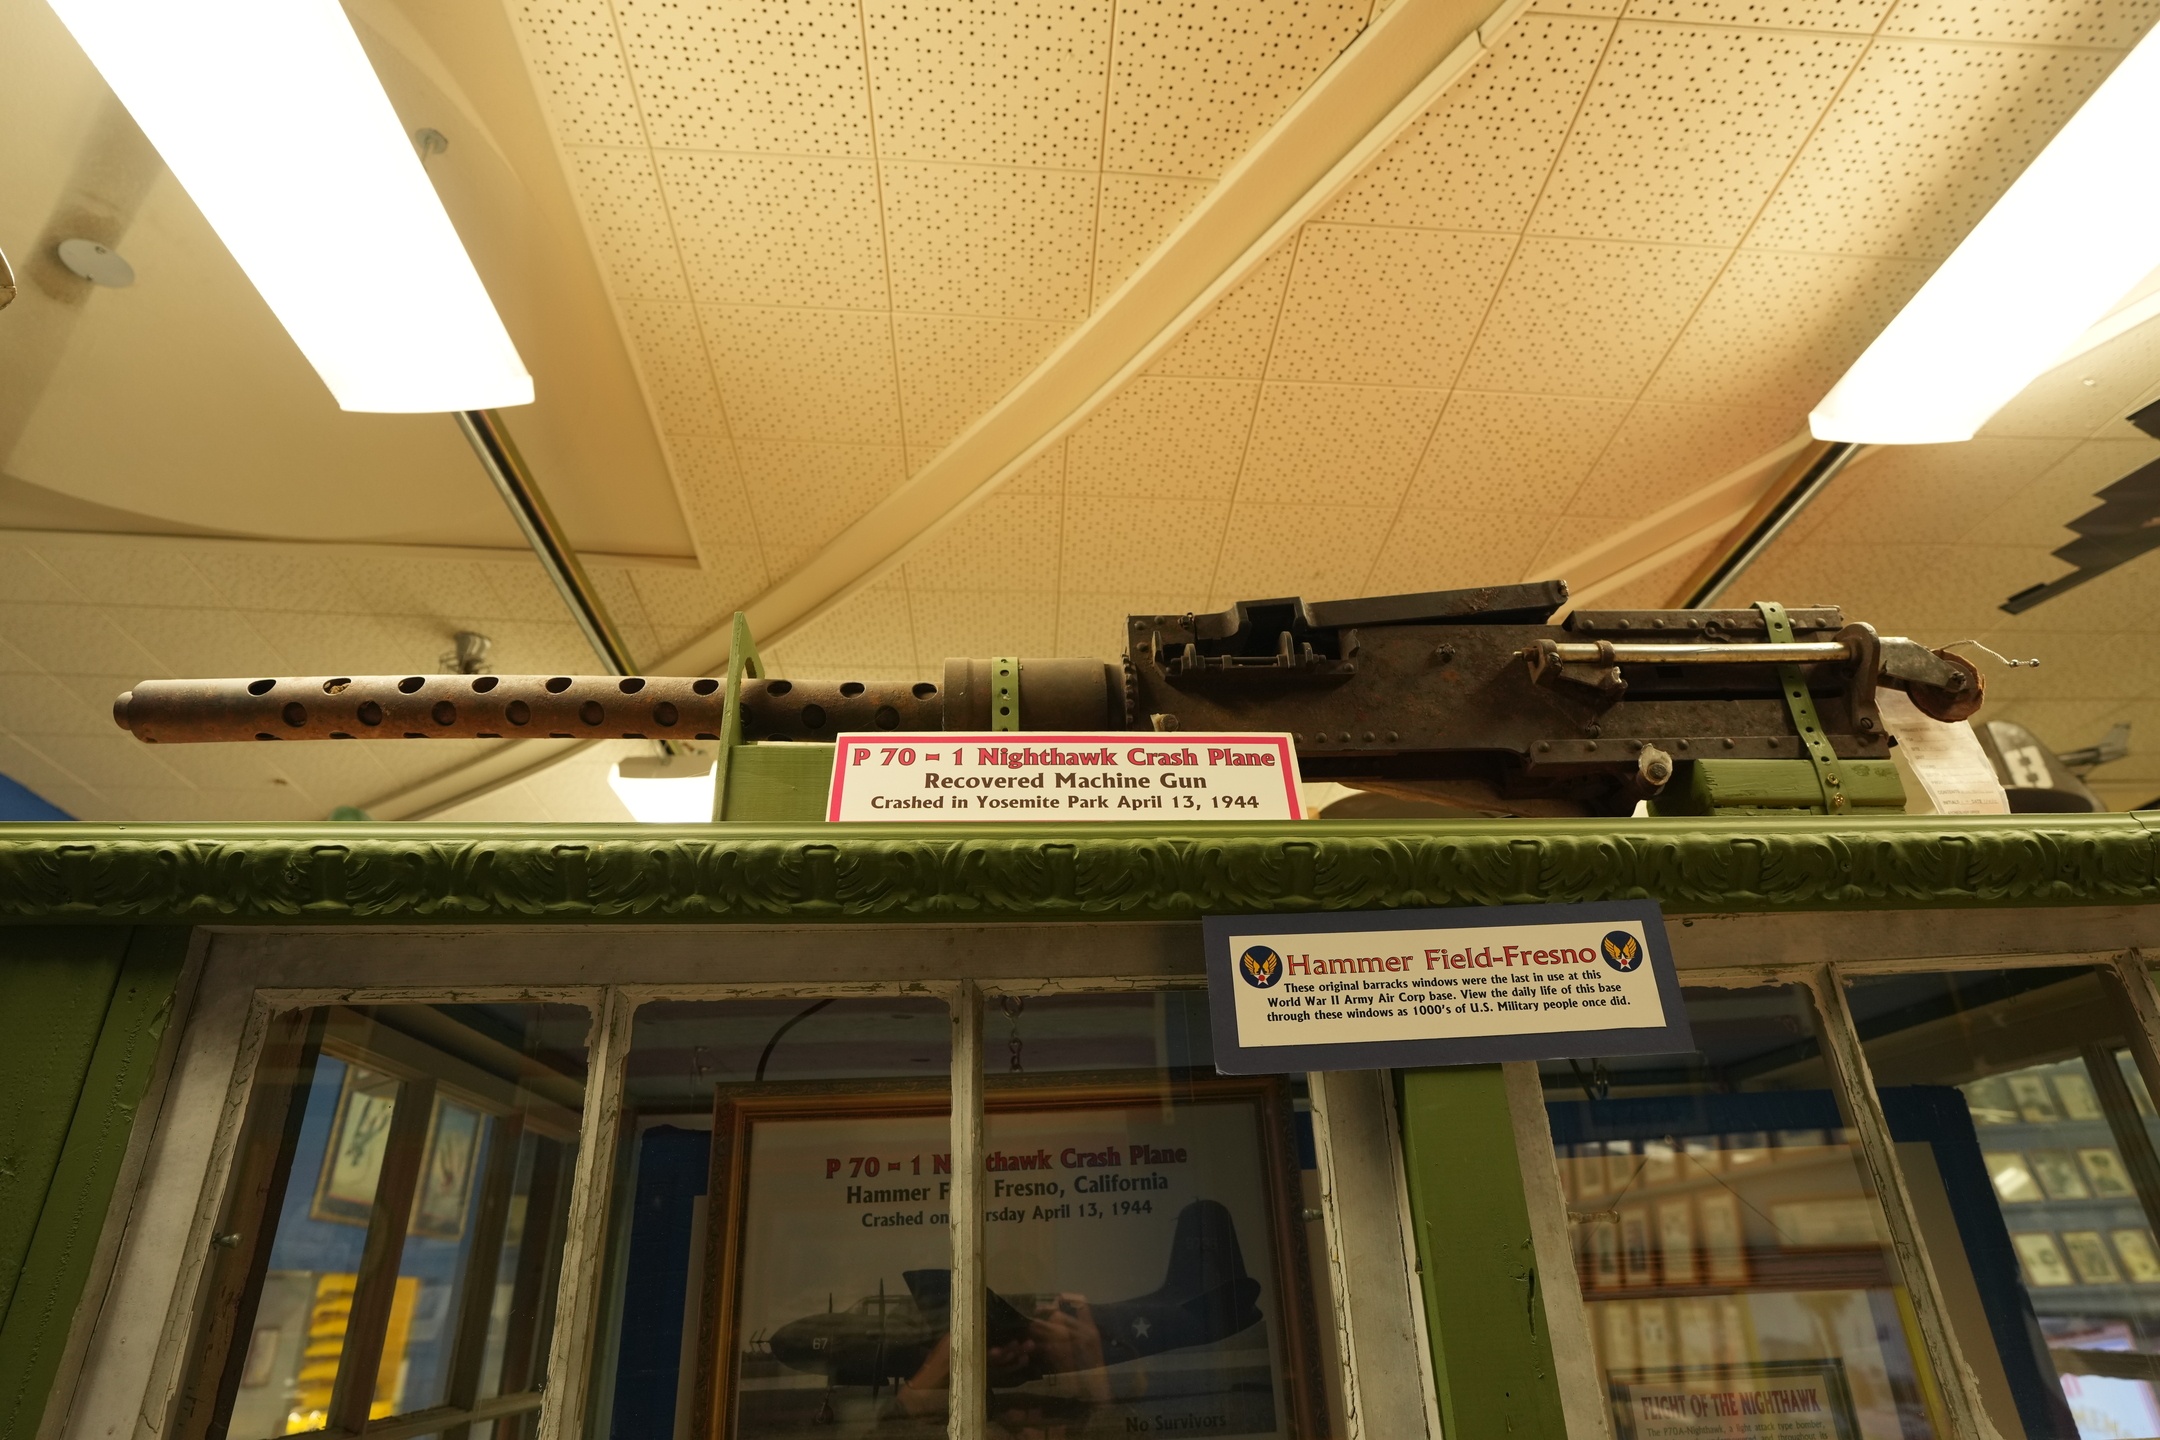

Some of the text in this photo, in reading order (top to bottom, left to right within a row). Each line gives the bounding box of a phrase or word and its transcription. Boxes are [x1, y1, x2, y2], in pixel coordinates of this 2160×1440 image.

[852, 747, 871, 766] P
[880, 747, 916, 766] 70
[952, 747, 963, 766] 1
[977, 747, 1118, 769] Nighthawk
[1127, 747, 1199, 766] Crash
[1207, 748, 1275, 766] Plane
[924, 772, 1207, 789] Recovered Machine Gun
[870, 795, 1260, 811] Crashed in Yosemite Park April 13, 1944
[1286, 946, 1597, 976] Hammer Field-Fresno
[1284, 970, 1602, 993] These original barracks windows were the last in use at this
[1267, 982, 1622, 1008] World War II Army Air Corp base. View the daily life of this base
[1267, 995, 1631, 1022] through these windows as 1000's of U.S. Military people once did.
[825, 1158, 841, 1179] P
[848, 1156, 880, 1178] 70
[910, 1155, 921, 1175] 1
[932, 1149, 1053, 1175] Nthawk
[1060, 1146, 1121, 1168] Crash
[1129, 1144, 1188, 1165] Plane
[846, 1184, 931, 1204] Hammer
[994, 1177, 1065, 1198] Fresno,
[1073, 1172, 1169, 1194] California
[861, 1199, 1153, 1228] Crashed on rsday April 13, 1944
[812, 1337, 828, 1350] 67
[1641, 1388, 1822, 1420] FLIGHT OF THE NIGHTHAWK
[1125, 1414, 1227, 1433] No Survivors
[1646, 1428, 1661, 1438] The
[1735, 1423, 1751, 1435] light
[1754, 1422, 1775, 1432] attack
[1777, 1422, 1793, 1434] type
[1795, 1420, 1826, 1430] bomber,
[1819, 1431, 1829, 1440] its
